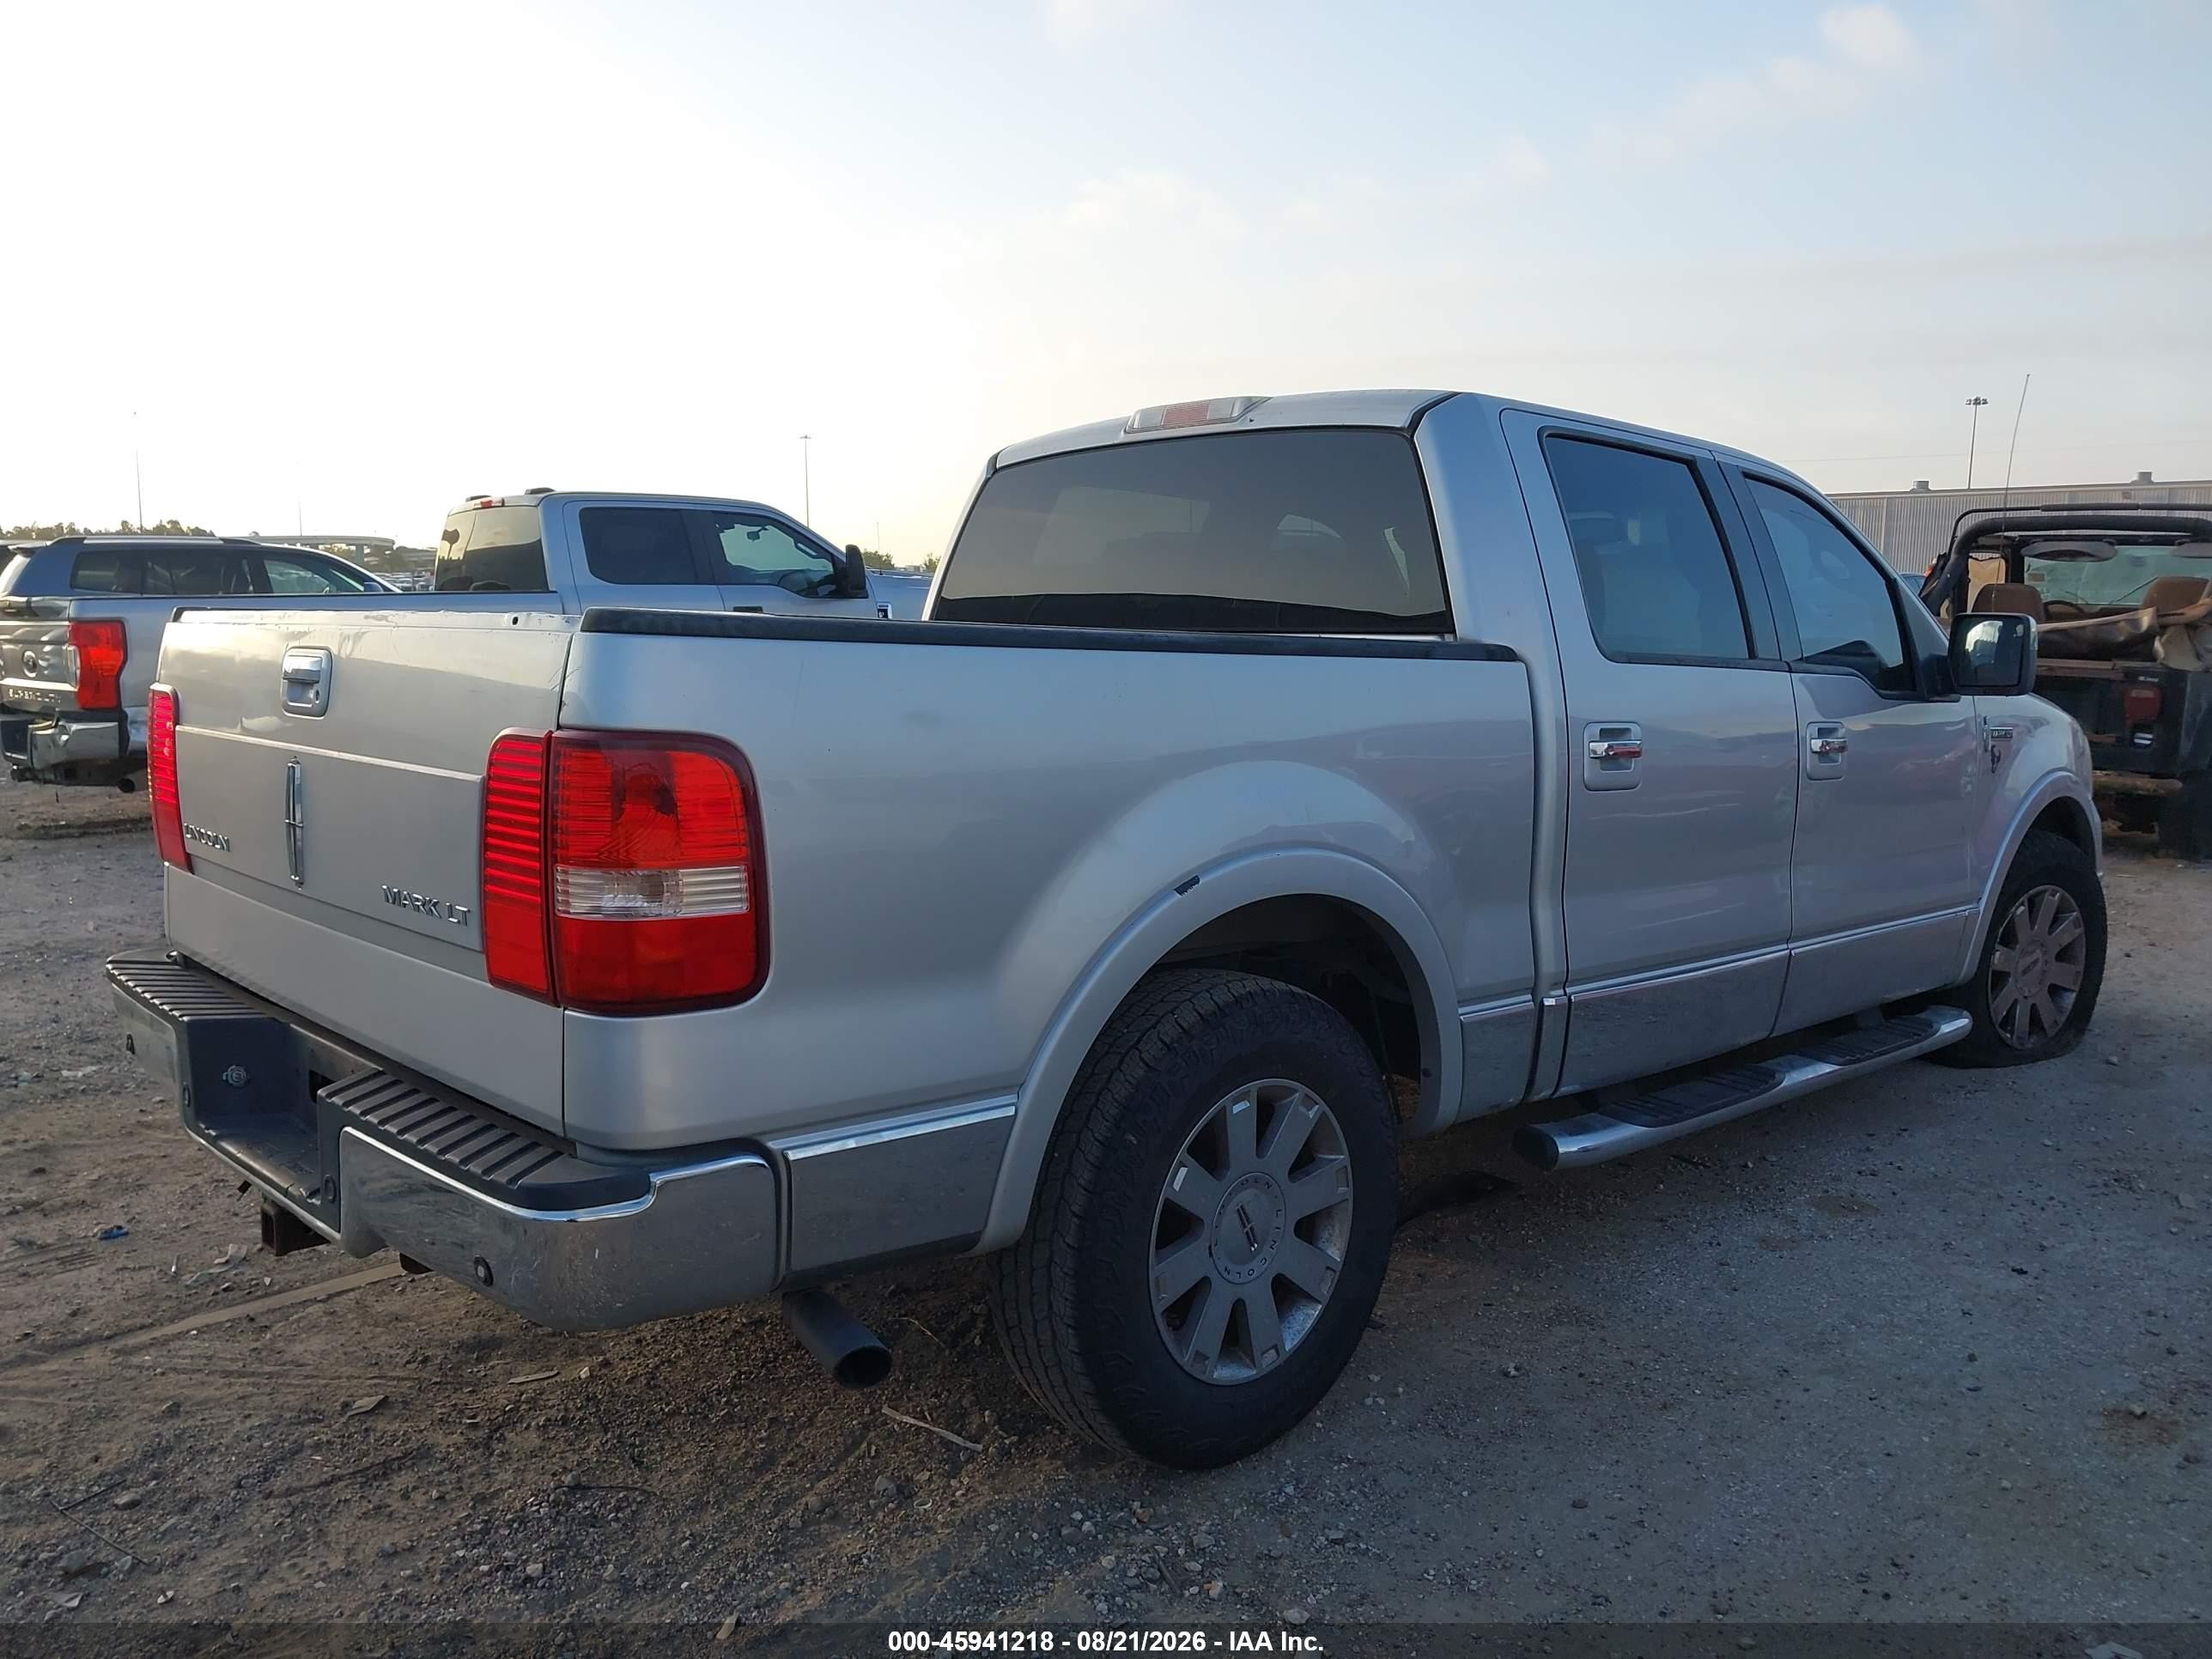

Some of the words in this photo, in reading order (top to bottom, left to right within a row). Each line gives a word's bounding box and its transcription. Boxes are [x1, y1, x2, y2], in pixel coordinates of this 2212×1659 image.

[184, 823, 230, 852] LINCOLN
[381, 884, 442, 919] MARK
[446, 902, 471, 927] LT
[1224, 1209, 1282, 1279] LINCOLN
